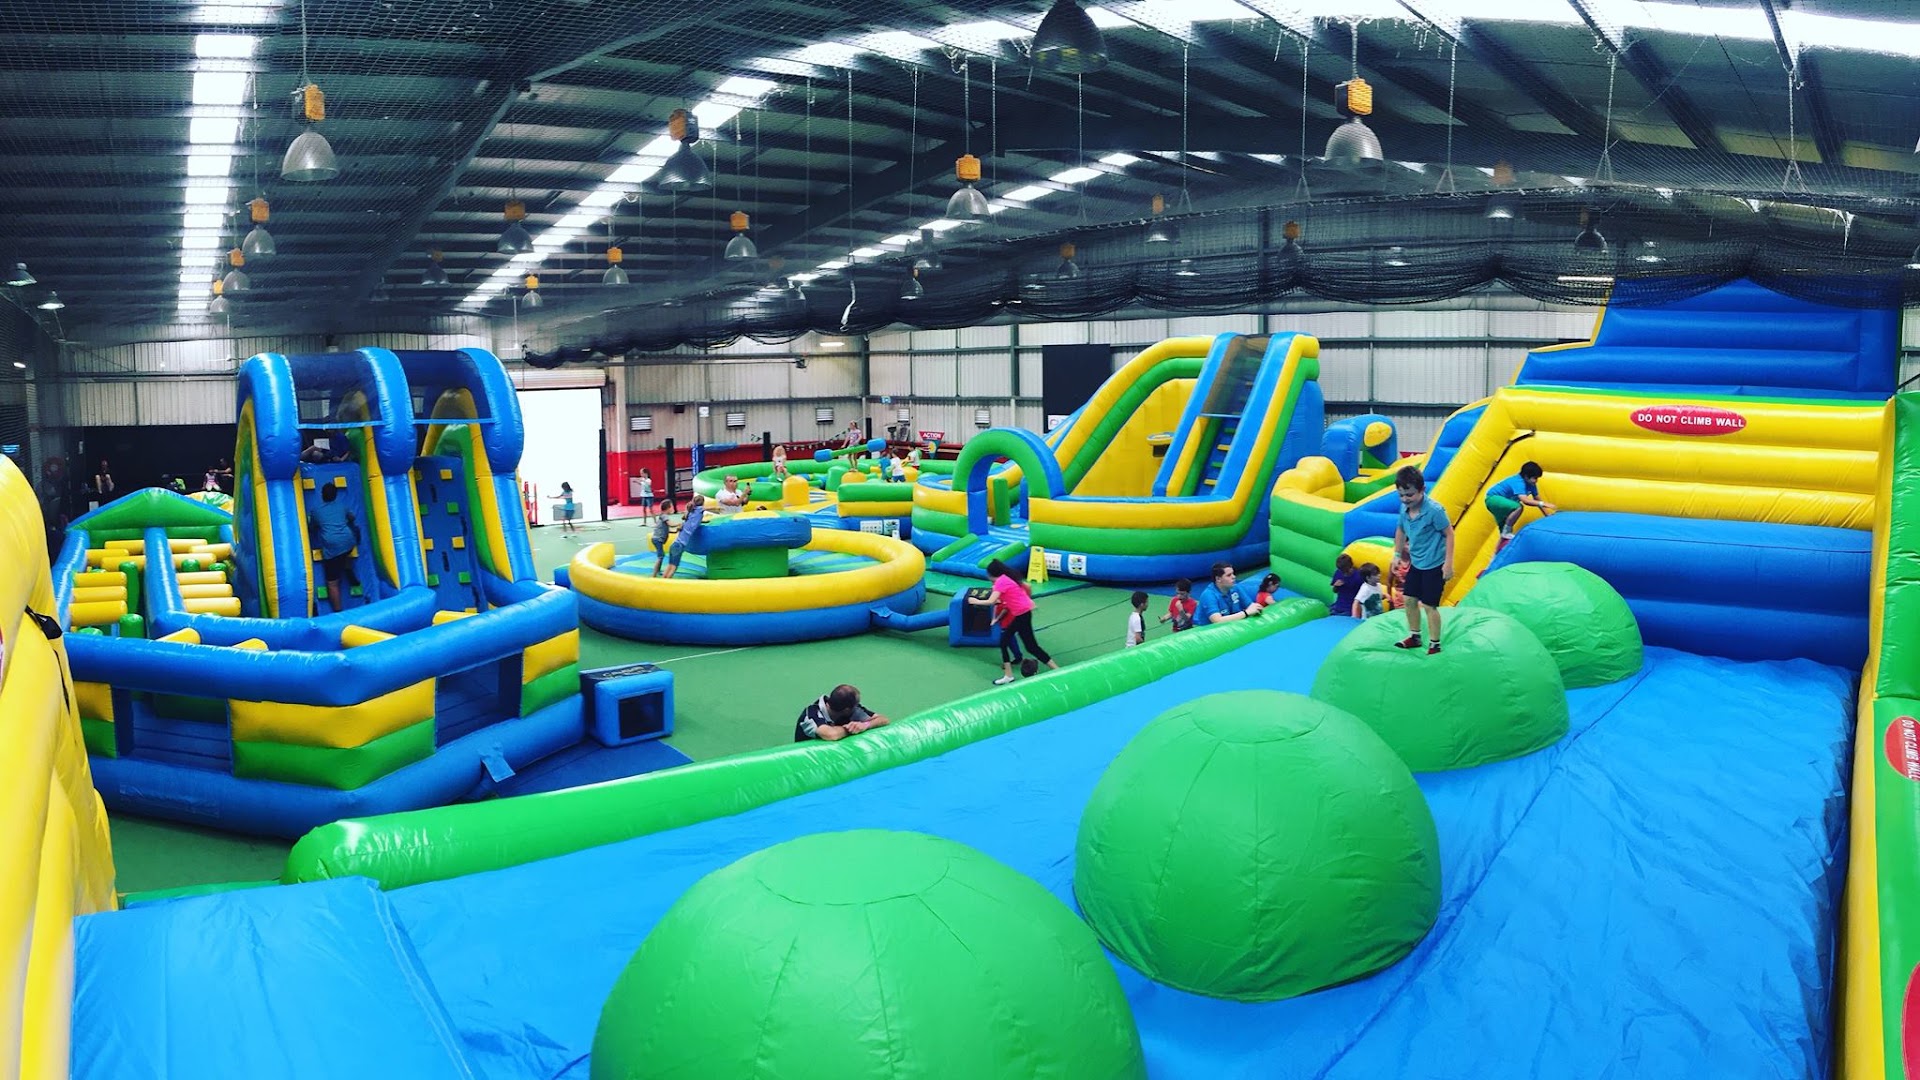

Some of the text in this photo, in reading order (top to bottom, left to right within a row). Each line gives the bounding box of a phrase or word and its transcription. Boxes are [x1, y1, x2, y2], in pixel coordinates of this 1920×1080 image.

[1638, 413, 1744, 428] DO NOT CLIMB WALL
[1902, 719, 1920, 779] DO NOT CLIMB WALL
